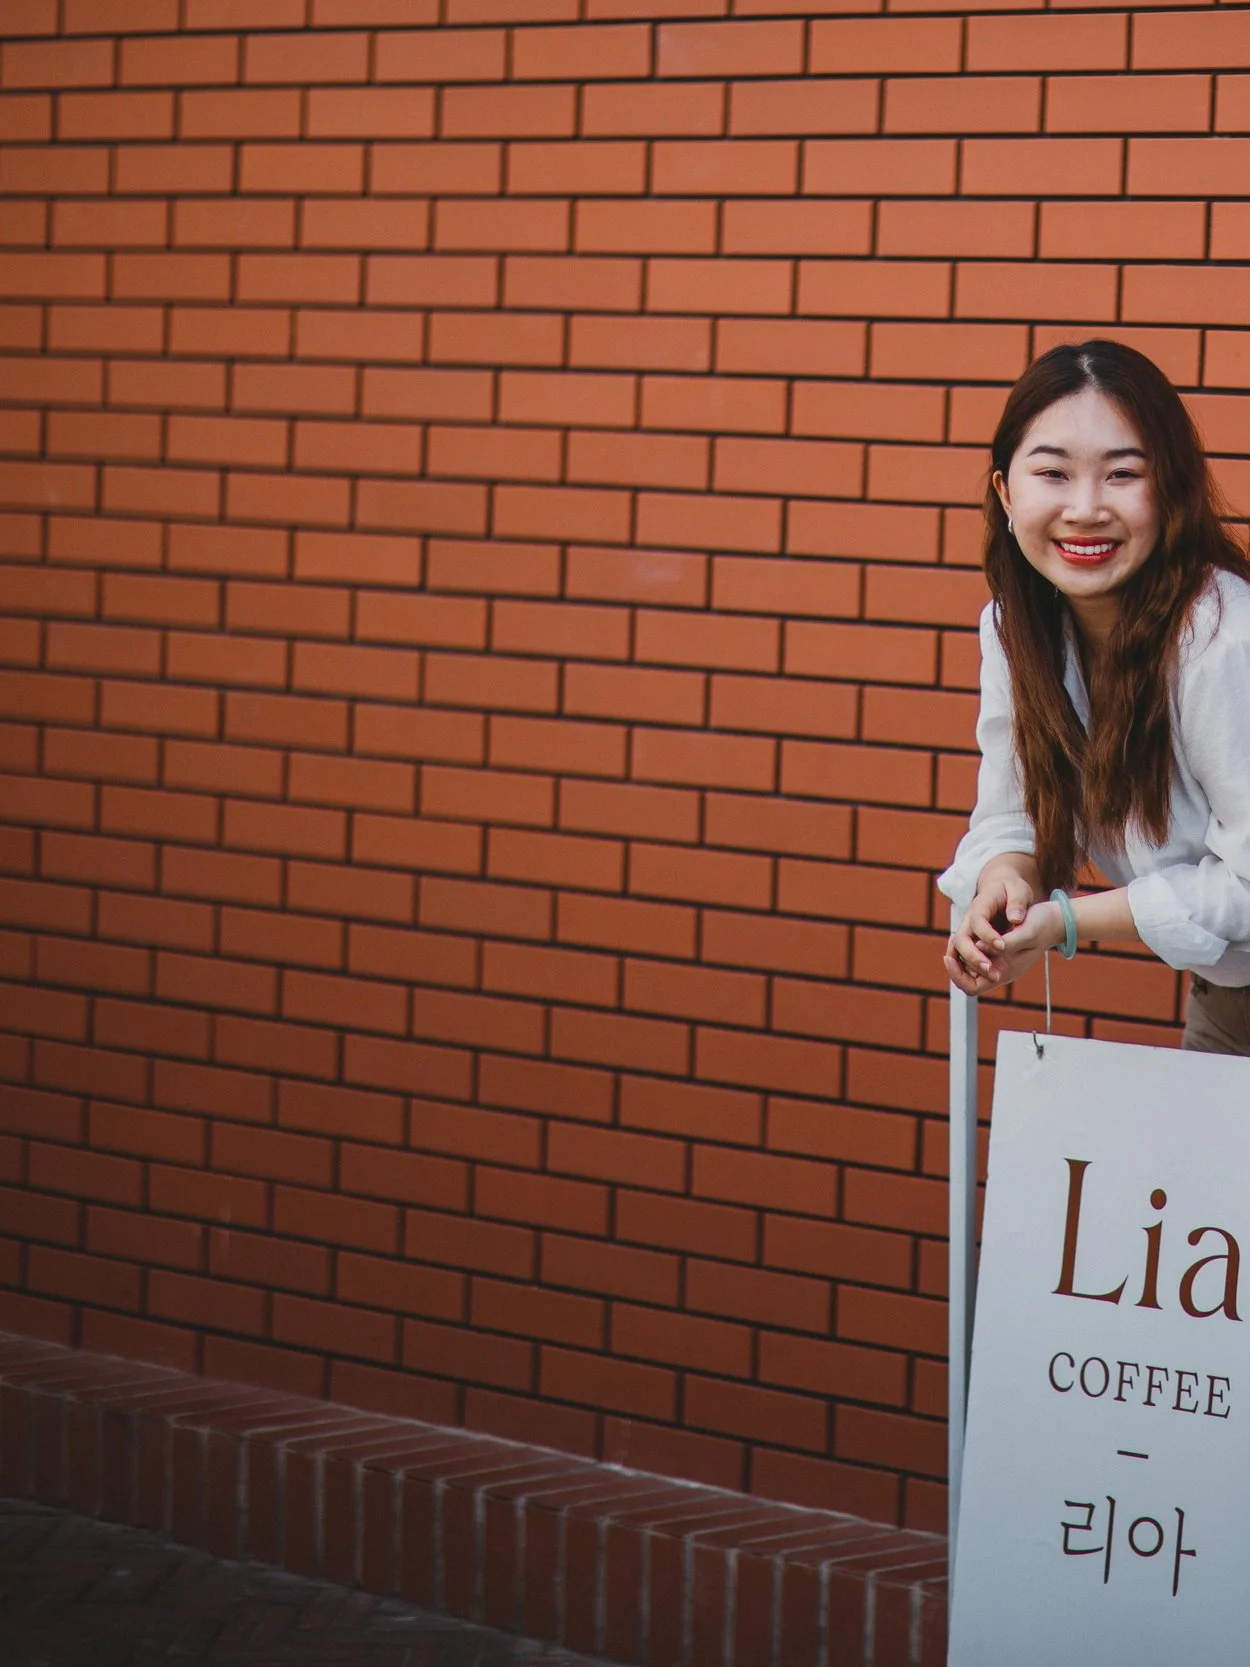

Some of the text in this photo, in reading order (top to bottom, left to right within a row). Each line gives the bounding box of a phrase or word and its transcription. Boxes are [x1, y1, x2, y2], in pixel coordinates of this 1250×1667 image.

[1051, 1158, 1243, 1322] Lia
[1048, 1352, 1232, 1419] COFFEE
[1060, 1495, 1197, 1597] 리아
